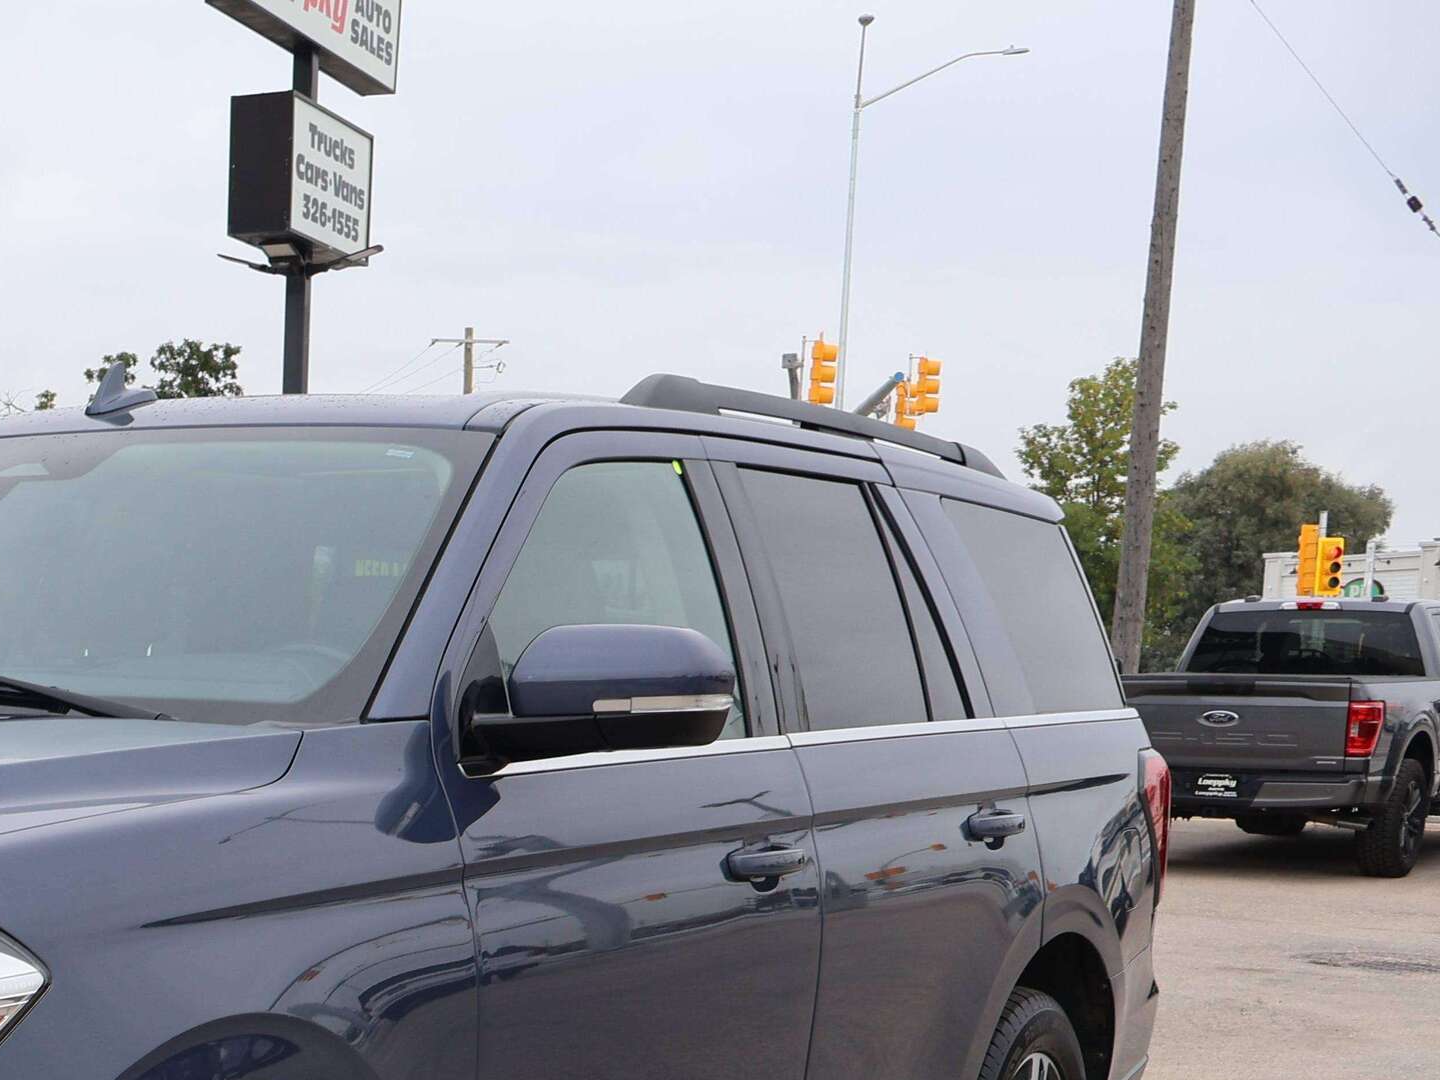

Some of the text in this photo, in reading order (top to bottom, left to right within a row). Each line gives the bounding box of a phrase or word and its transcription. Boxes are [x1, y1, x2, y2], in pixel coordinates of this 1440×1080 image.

[355, 0, 392, 34] AUTO
[350, 18, 393, 66] SALES
[309, 122, 355, 170] Trucks
[302, 193, 359, 242] 326-1555
